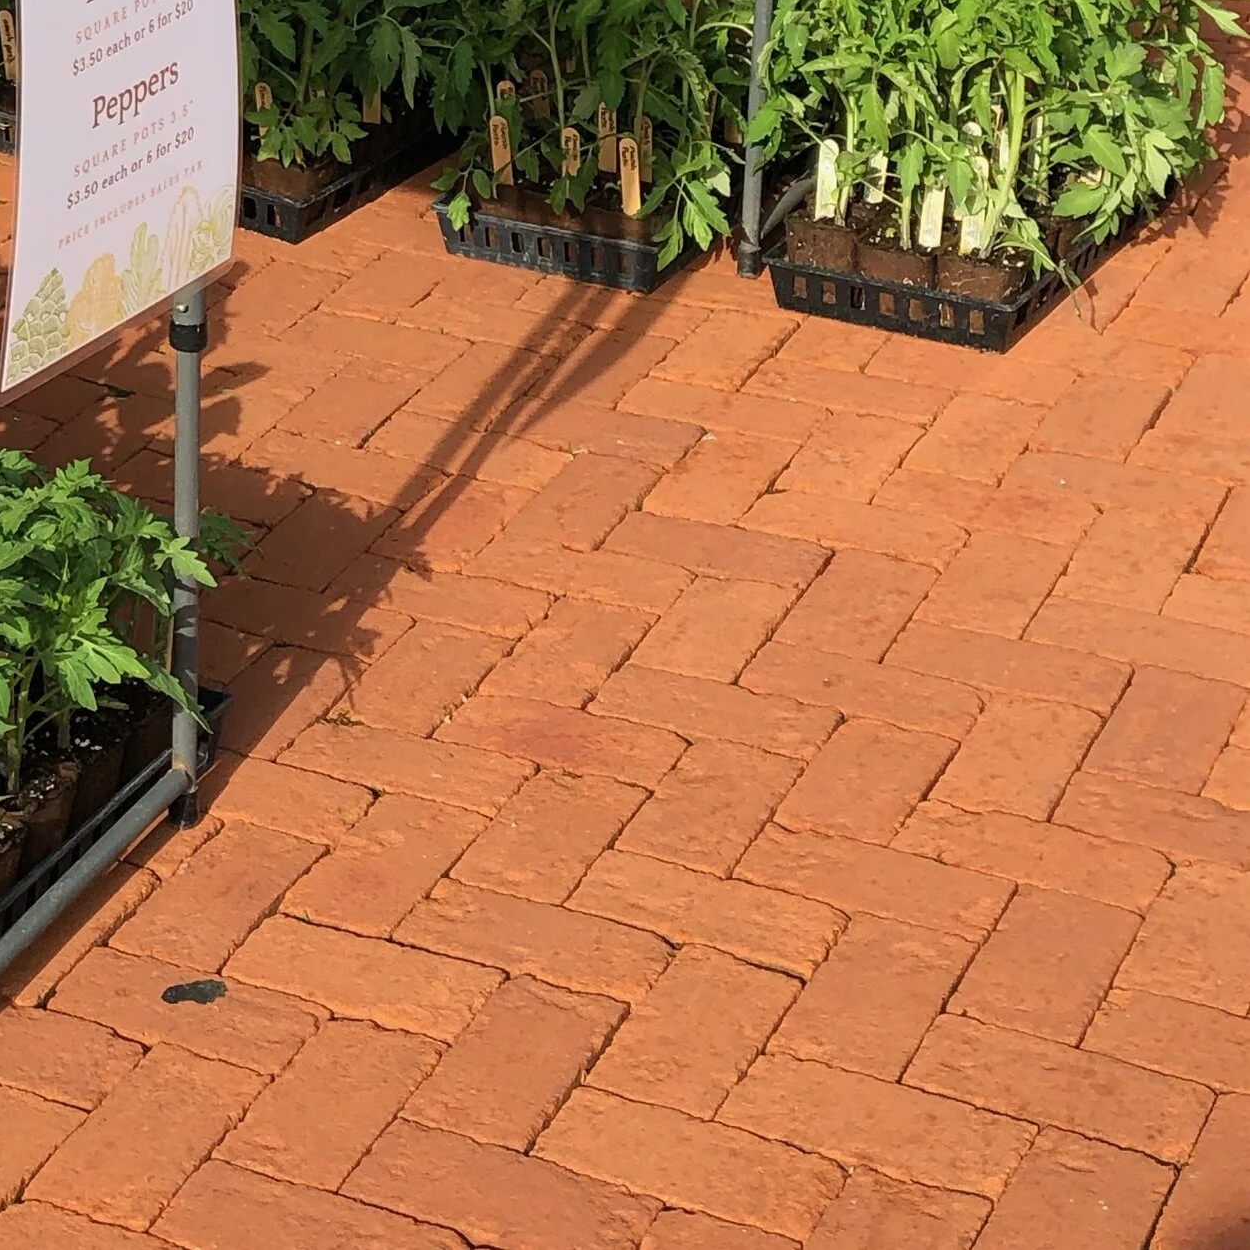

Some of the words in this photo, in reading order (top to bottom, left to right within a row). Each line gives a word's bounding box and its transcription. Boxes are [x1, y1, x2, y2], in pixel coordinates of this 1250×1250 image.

[72, 48, 103, 77] $3.50
[106, 32, 132, 57] each
[134, 26, 146, 42] or
[148, 18, 155, 34] 6
[157, 11, 172, 29] for
[75, 5, 128, 45] SQUARE
[92, 61, 179, 129] Peppers
[66, 180, 98, 210] $3.50
[101, 164, 128, 189] each
[131, 158, 144, 173] or
[146, 150, 153, 164] 6
[156, 141, 172, 159] for
[174, 126, 194, 149] $20
[73, 138, 127, 178] SQUARE
[133, 117, 165, 145] POTS
[58, 224, 90, 250] PRICE
[94, 193, 146, 229] INCLUDES
[150, 173, 180, 198] SALES
[183, 160, 204, 178] TAX
